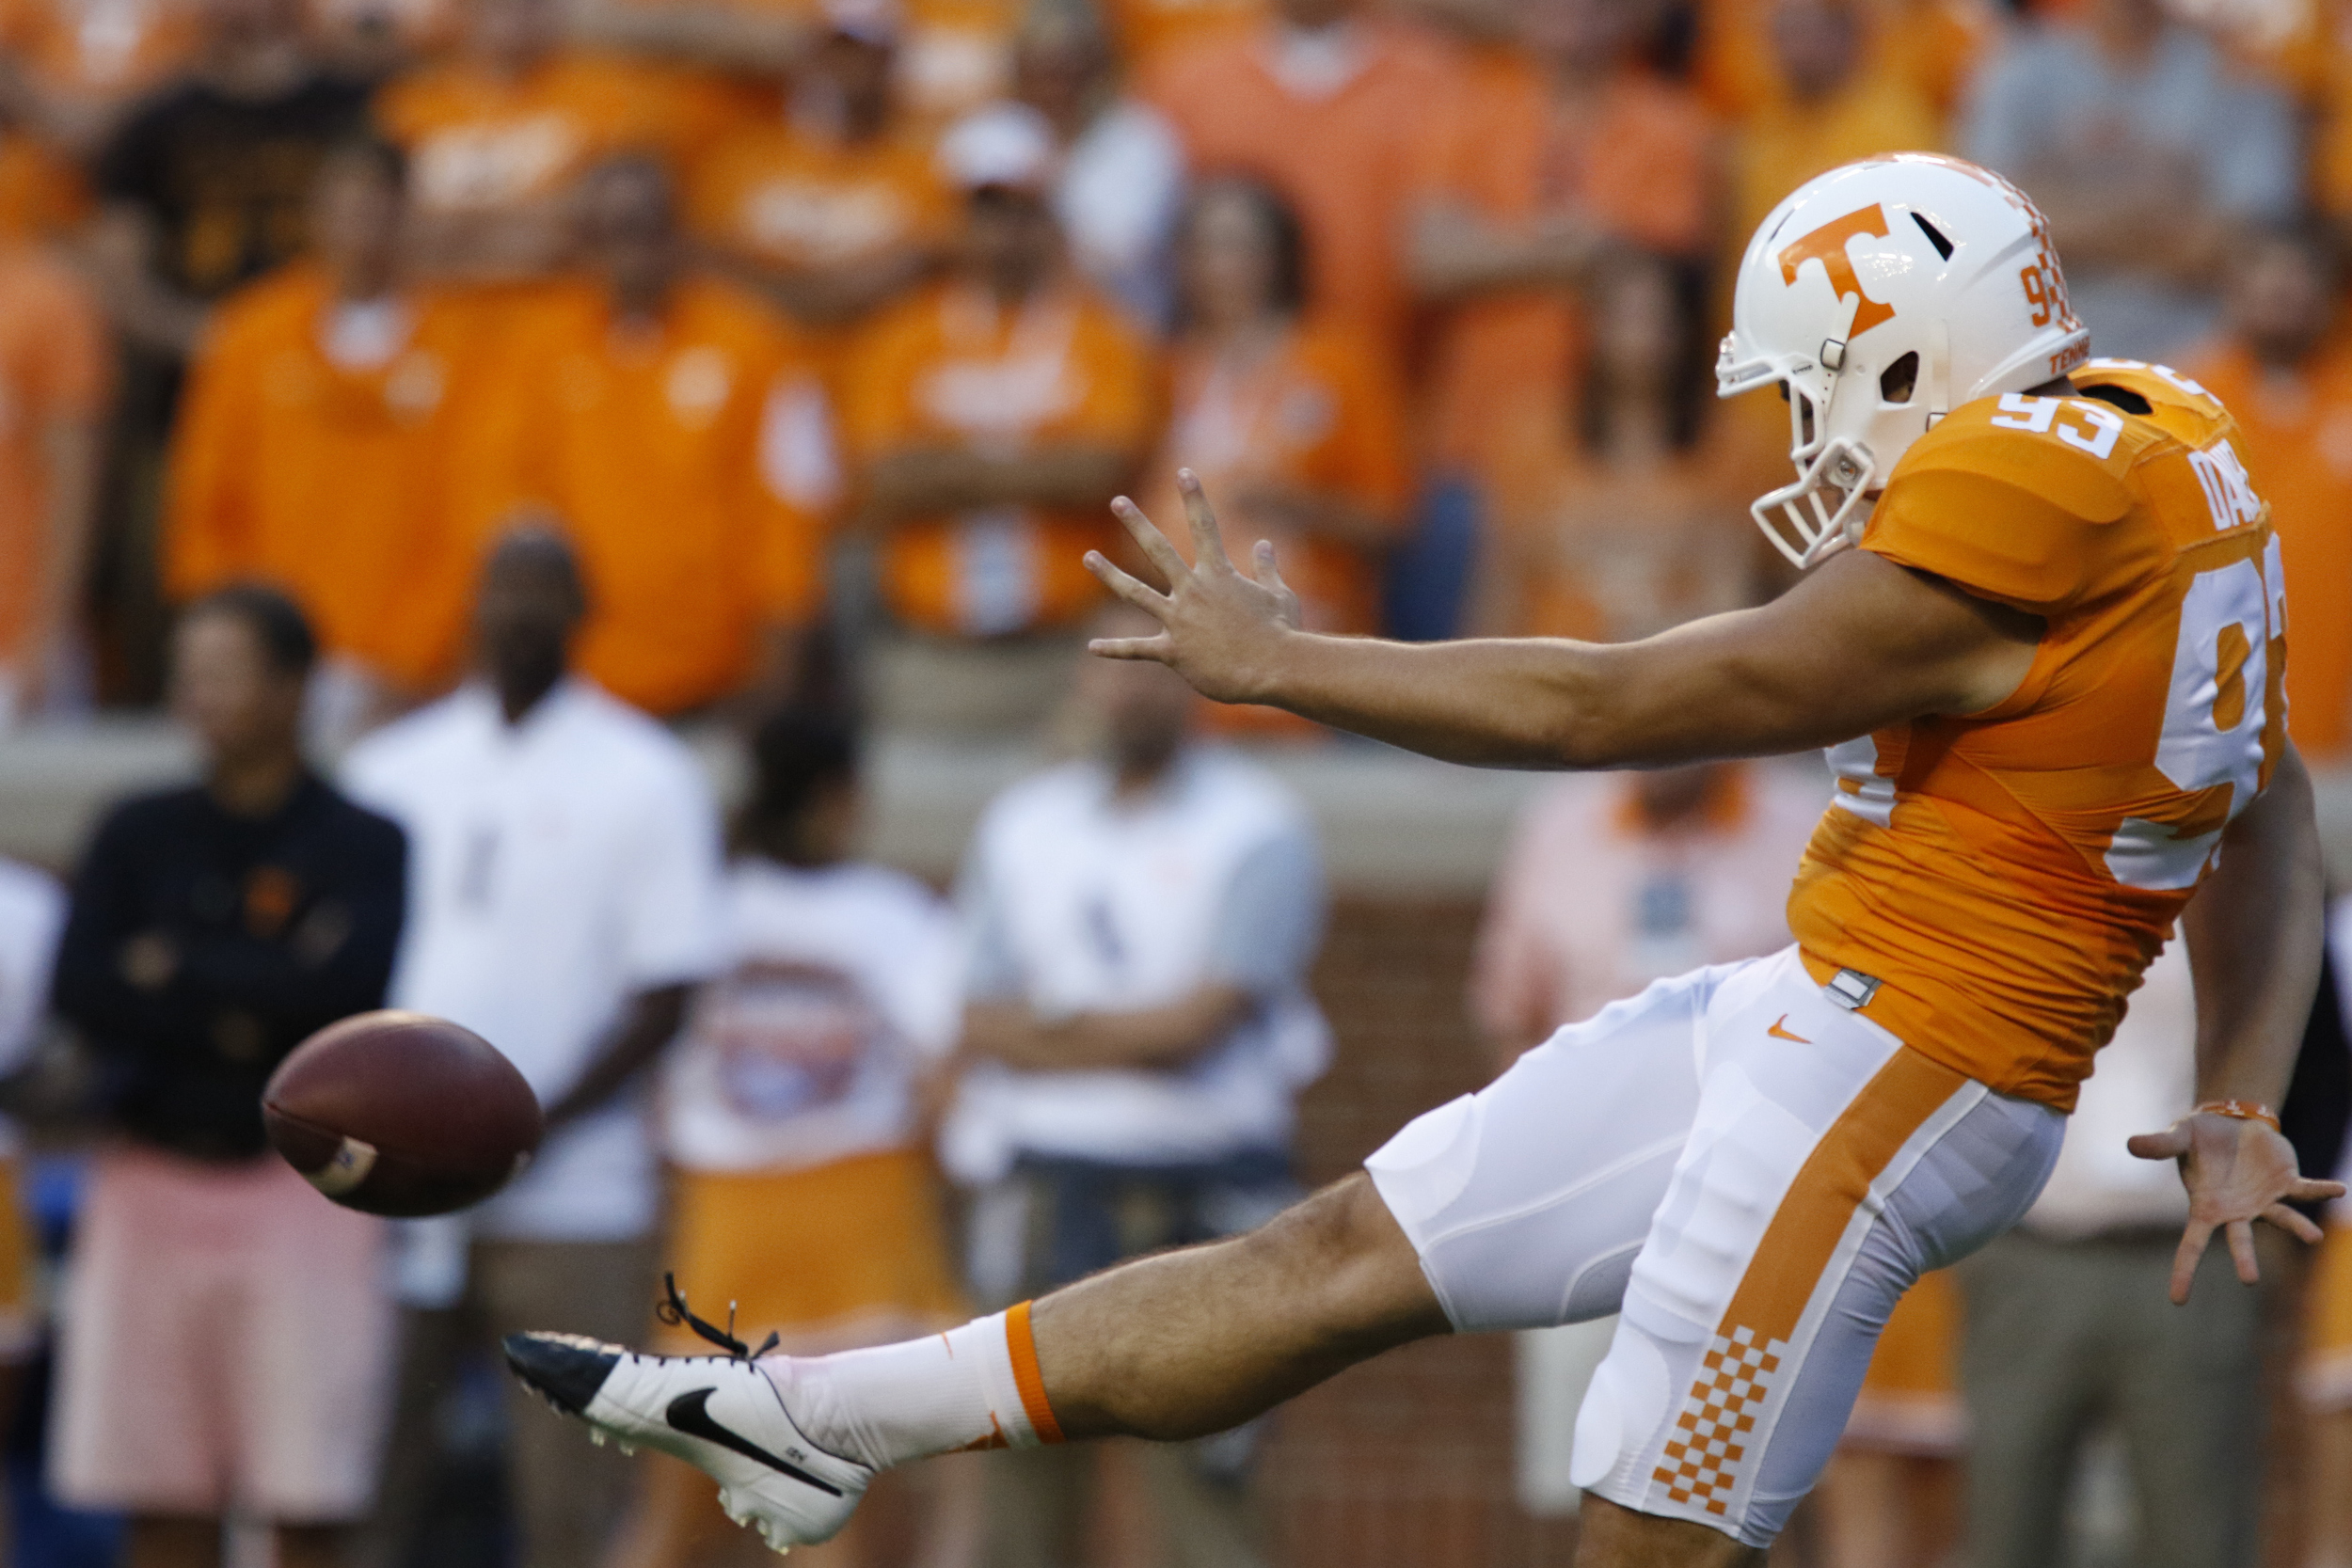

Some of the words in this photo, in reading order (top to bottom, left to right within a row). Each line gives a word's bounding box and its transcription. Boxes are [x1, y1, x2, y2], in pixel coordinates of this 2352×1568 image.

[1777, 202, 1897, 342] T
[2049, 335, 2090, 374] TENN
[1991, 391, 2124, 460] 93
